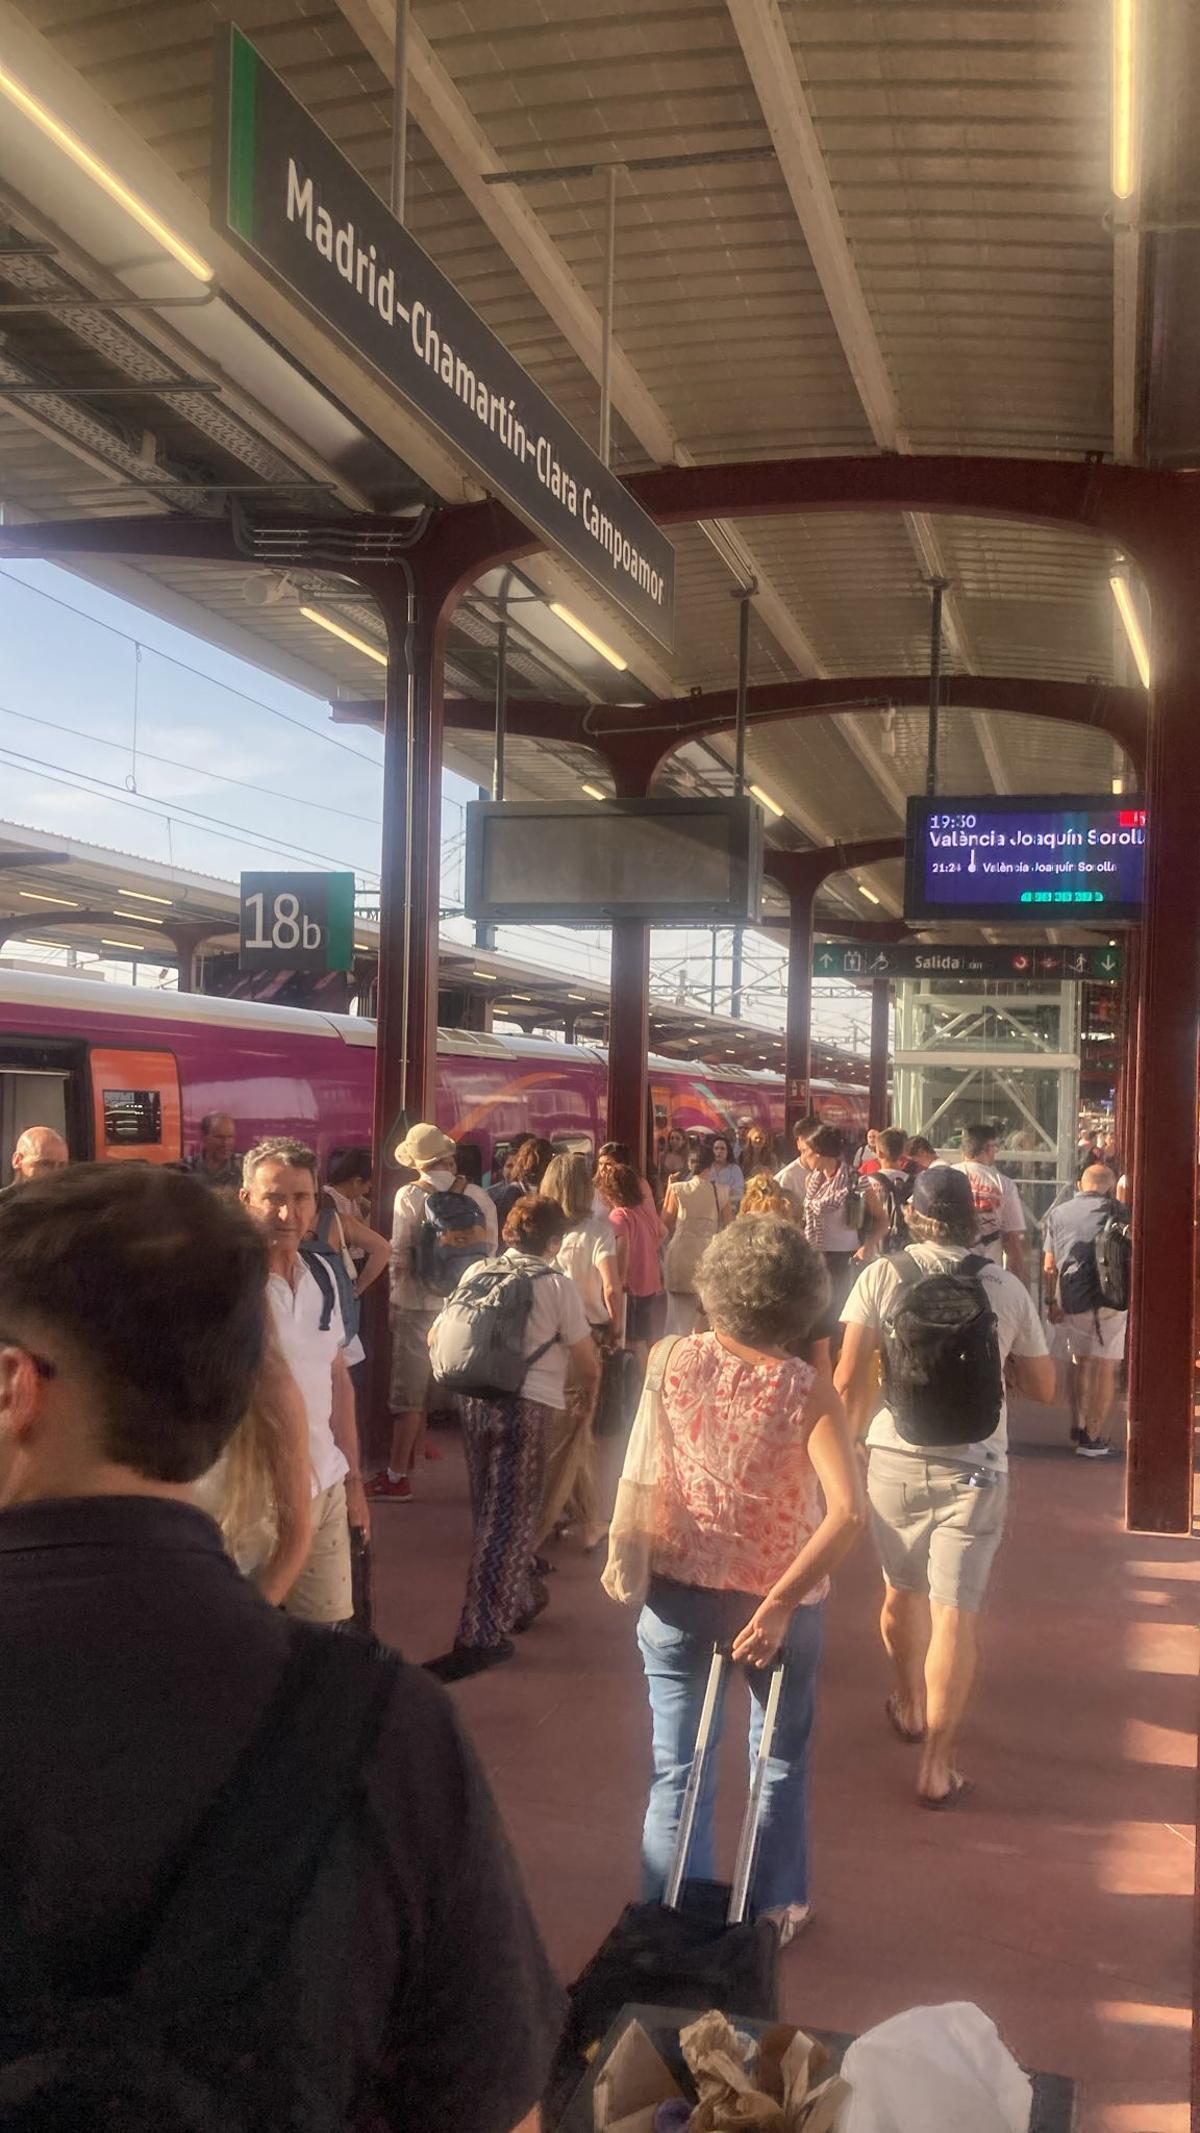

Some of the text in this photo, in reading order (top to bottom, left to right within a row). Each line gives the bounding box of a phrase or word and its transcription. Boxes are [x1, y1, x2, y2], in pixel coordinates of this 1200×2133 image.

[286, 157, 664, 606] Madrid-Chamartín-Clara Campoamor
[929, 828, 1146, 849] València Joaquín Soroll
[245, 892, 321, 950] 18b
[914, 955, 960, 970] Salida
